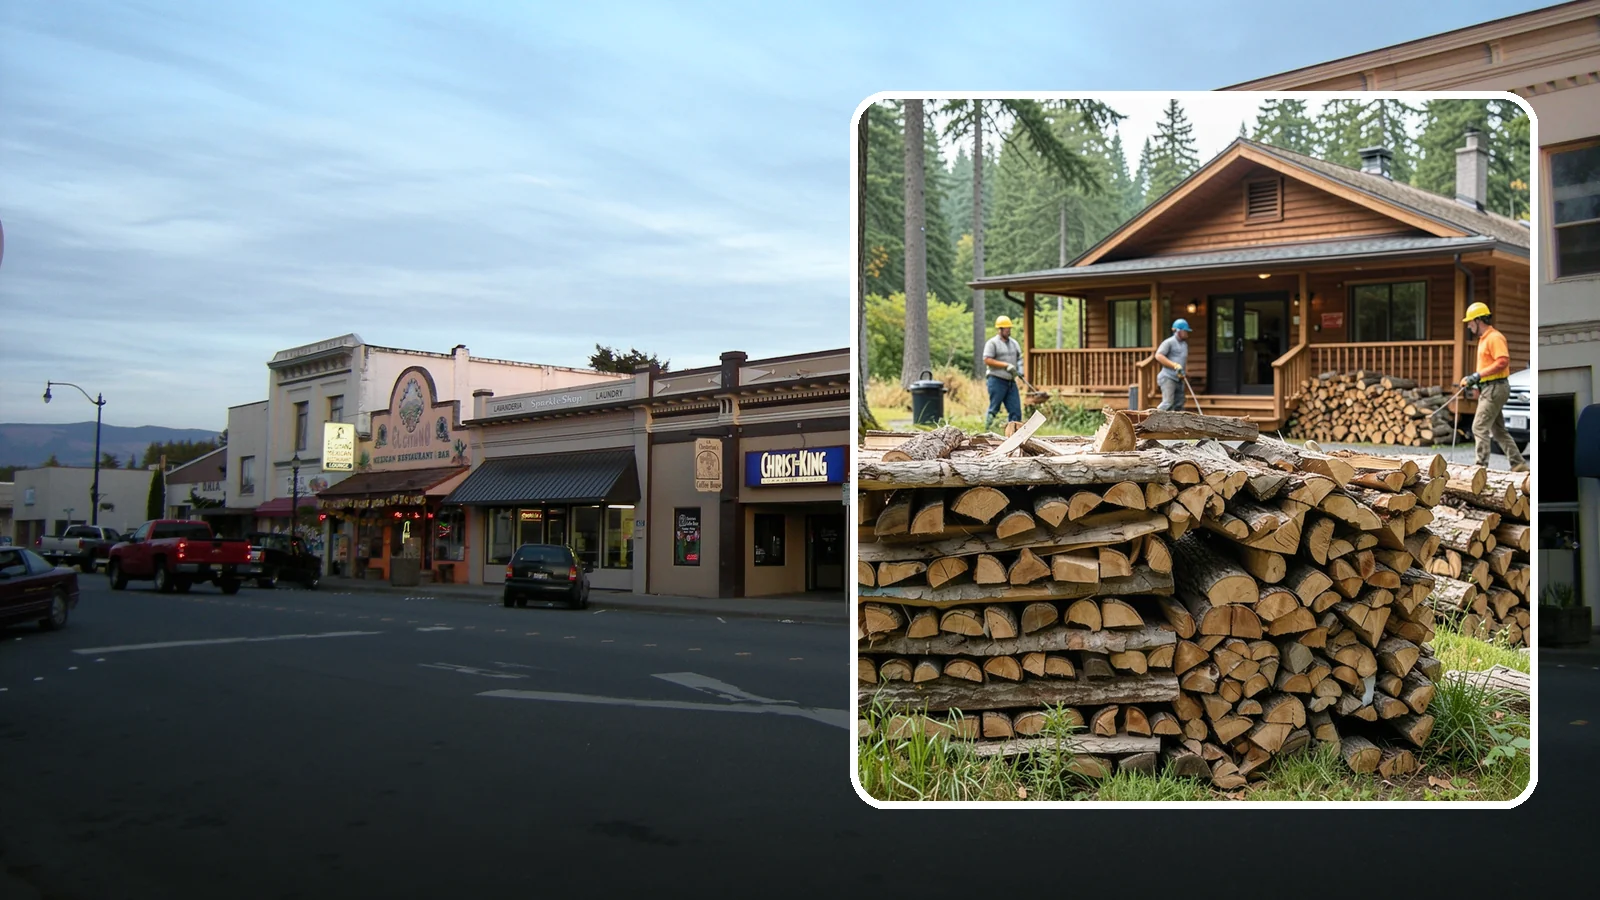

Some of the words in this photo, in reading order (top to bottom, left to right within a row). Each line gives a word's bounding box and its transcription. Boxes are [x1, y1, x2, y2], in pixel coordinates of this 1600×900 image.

[595, 389, 623, 400] LAUNDRY
[531, 399, 561, 409] Sparkle
[563, 394, 582, 406] Shop
[493, 402, 522, 413] LAVANDERIA
[398, 452, 433, 462] RESTAURANT
[438, 450, 450, 458] BAR
